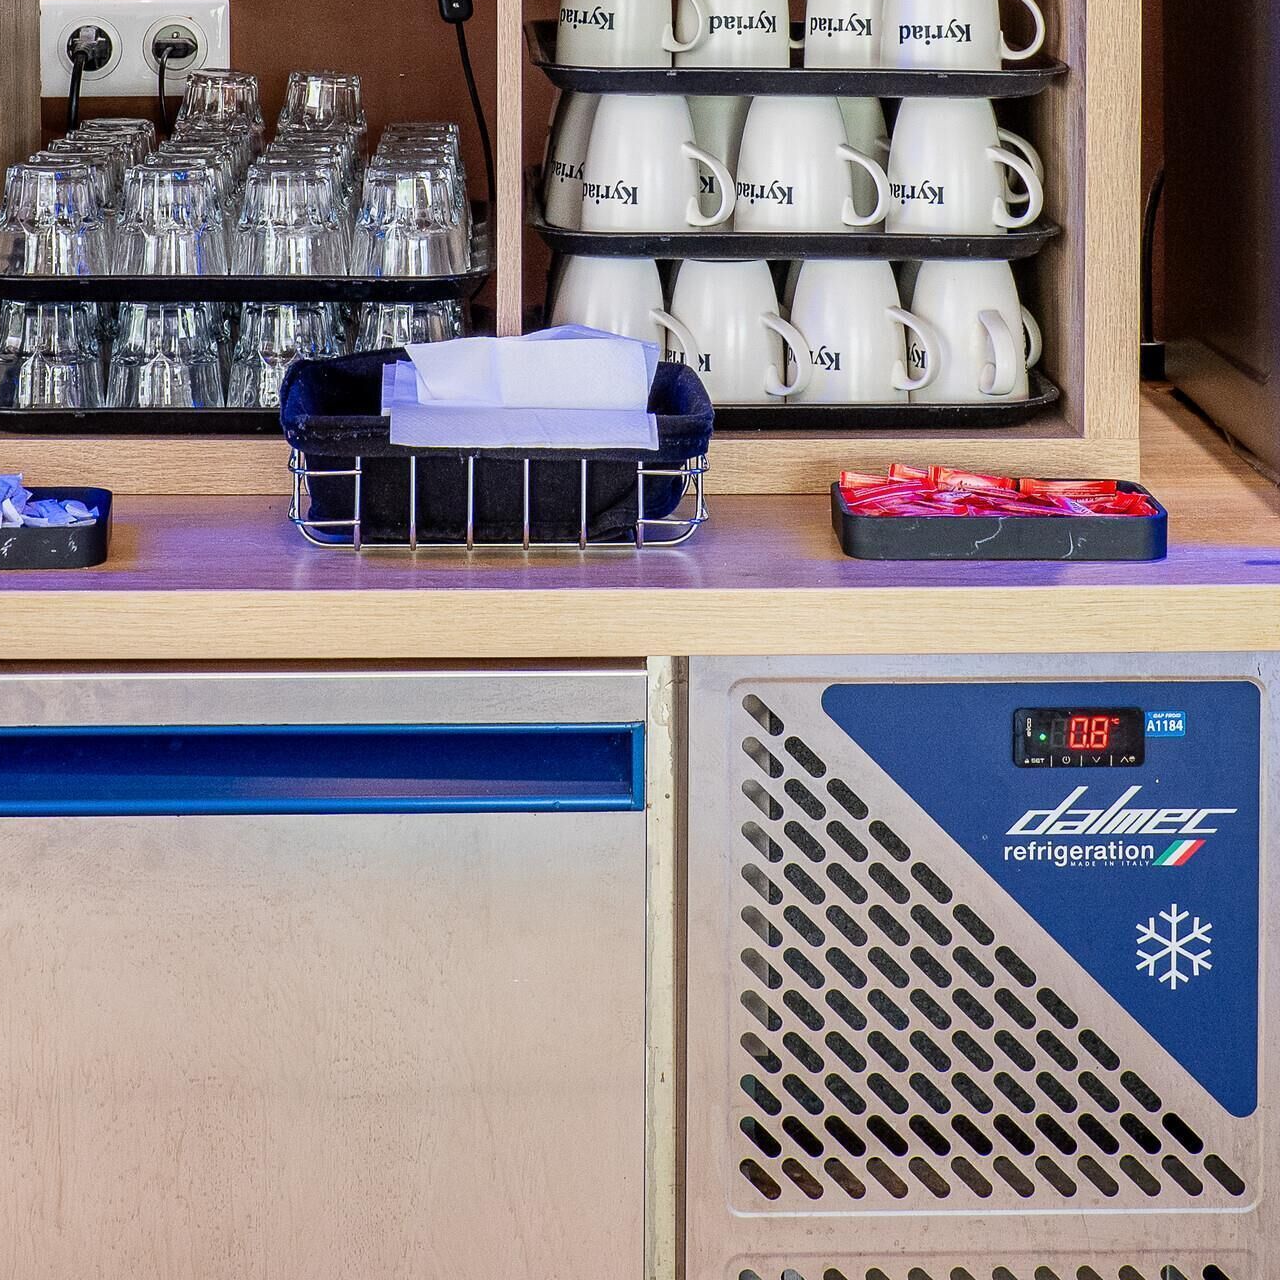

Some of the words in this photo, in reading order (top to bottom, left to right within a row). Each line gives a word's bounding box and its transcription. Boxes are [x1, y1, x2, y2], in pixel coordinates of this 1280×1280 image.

[559, 5, 616, 31] Kyriad
[708, 9, 778, 36] Kyriad
[809, 12, 874, 38] Kyriad
[898, 18, 973, 46] Kyriad
[1146, 720, 1184, 732] A1184
[1005, 785, 1239, 836] dalmec
[1003, 840, 1155, 867] refrigeration
